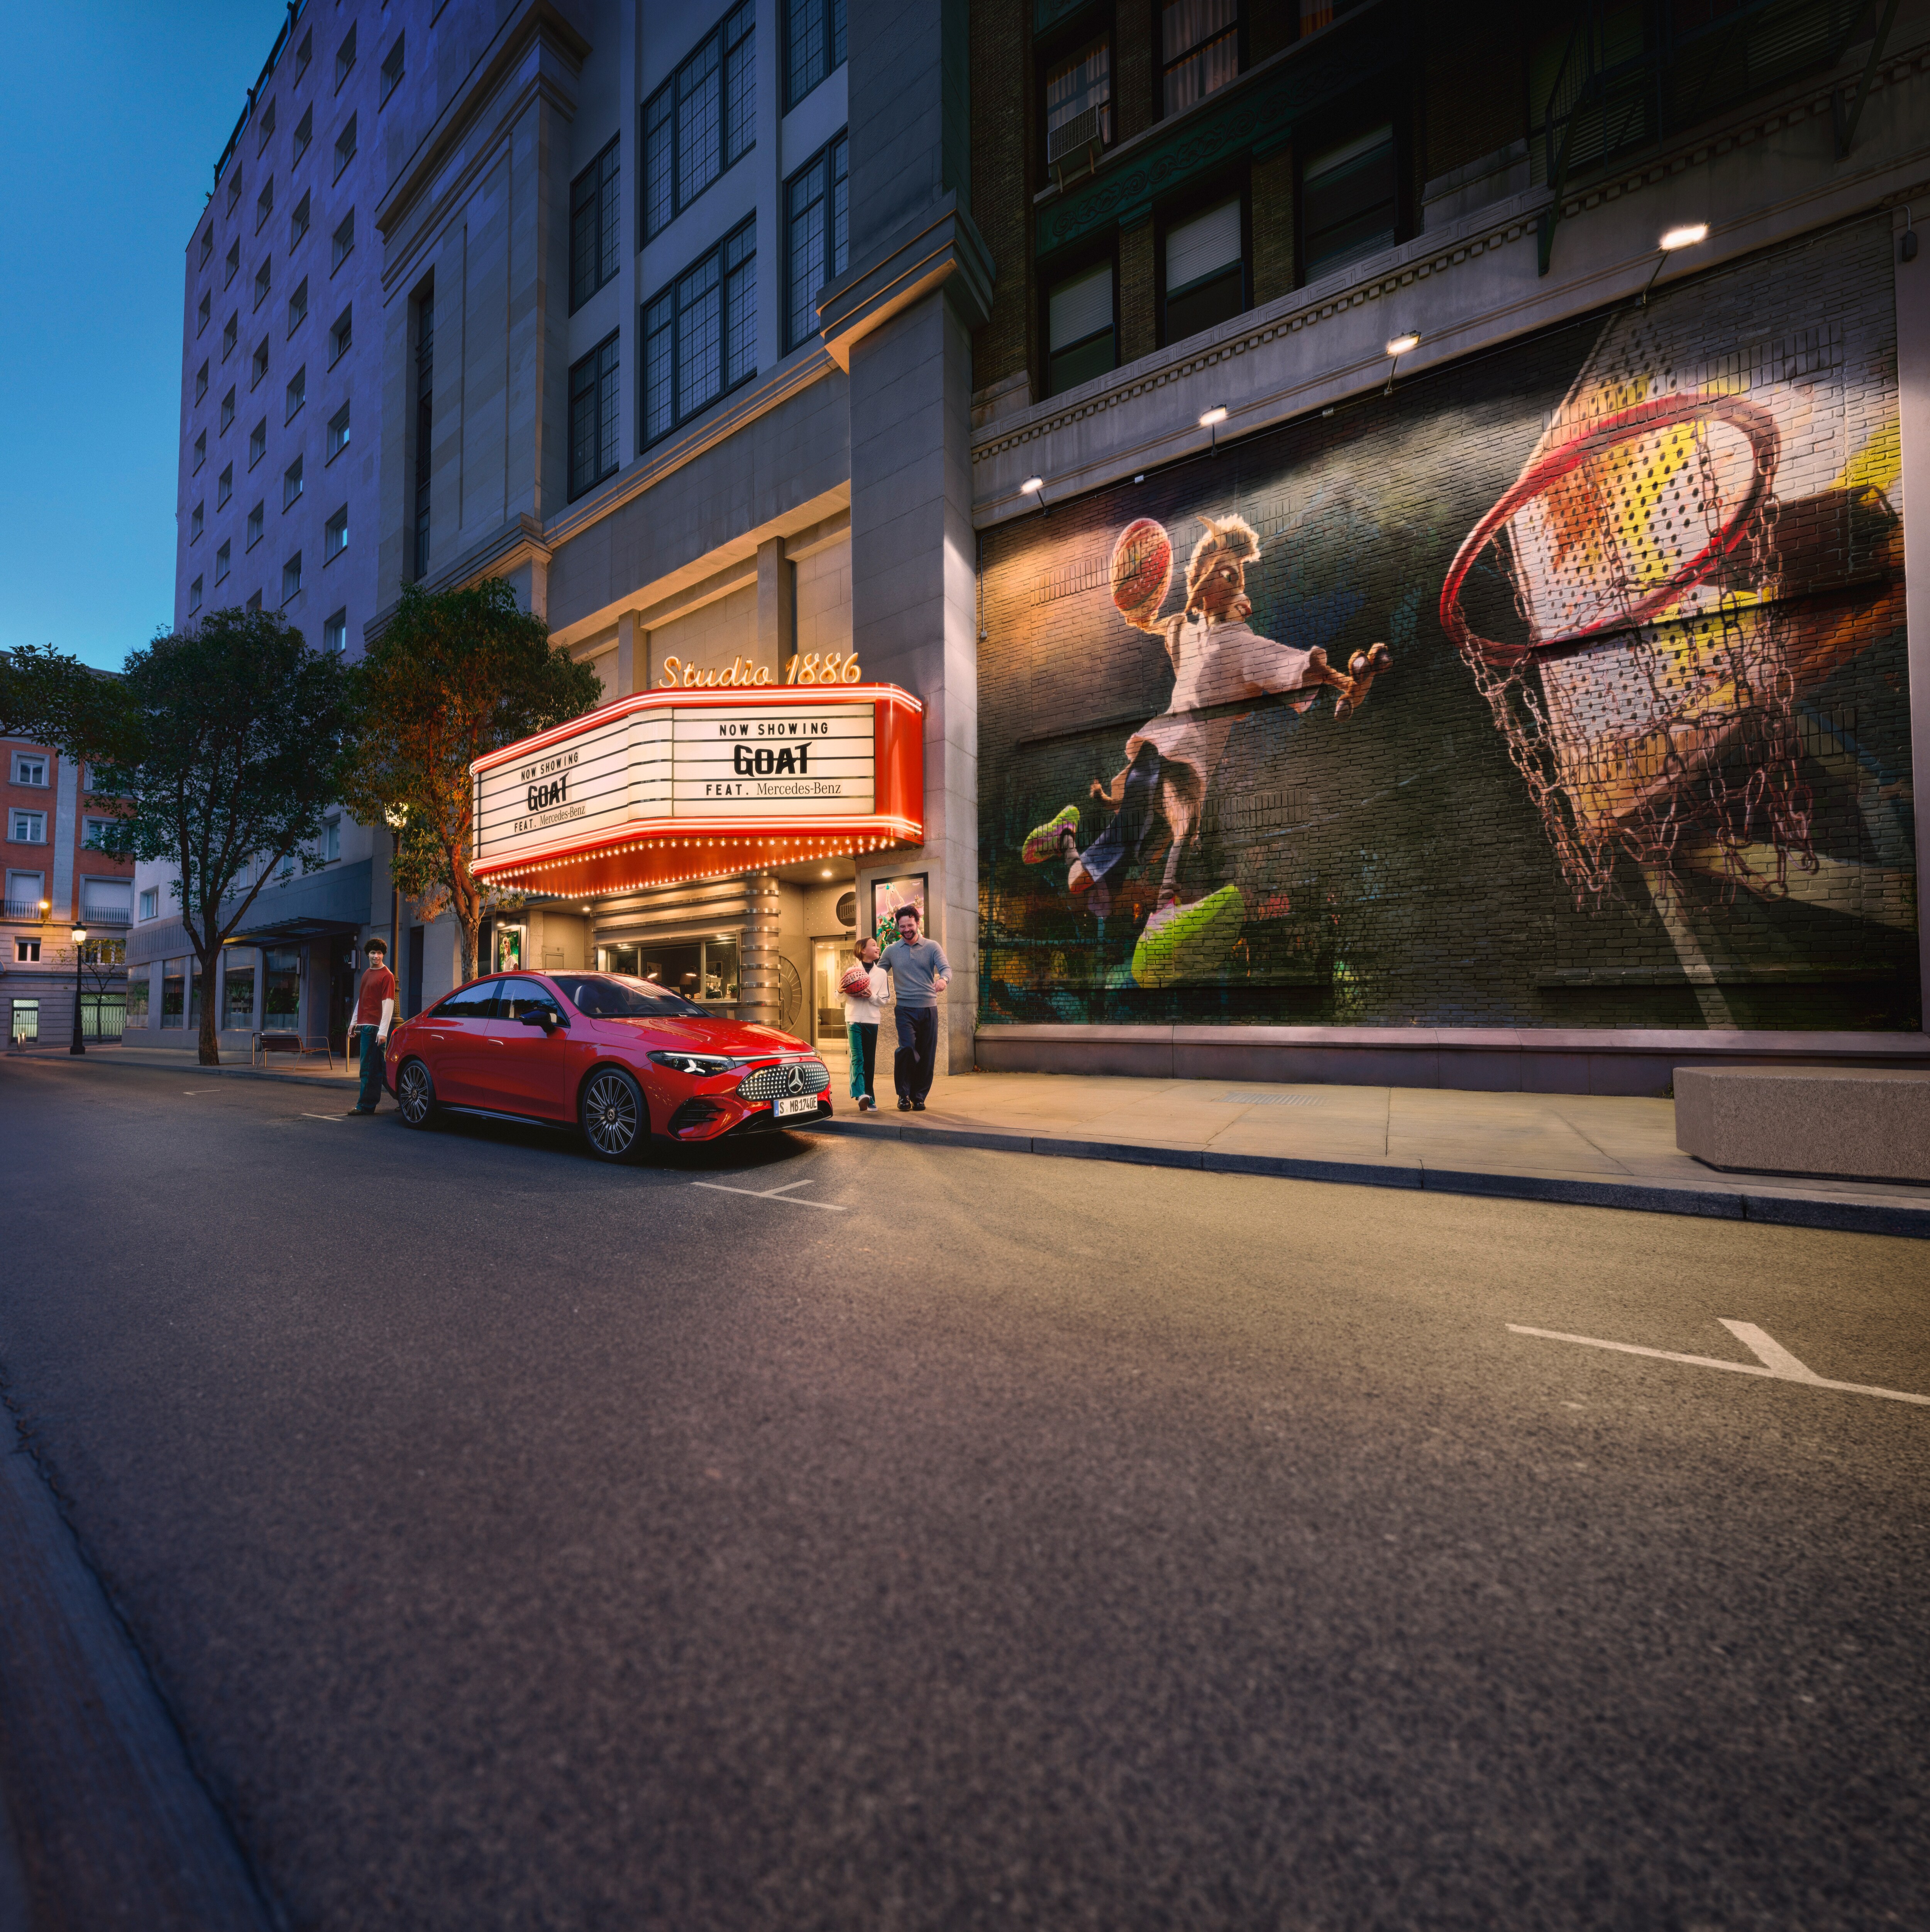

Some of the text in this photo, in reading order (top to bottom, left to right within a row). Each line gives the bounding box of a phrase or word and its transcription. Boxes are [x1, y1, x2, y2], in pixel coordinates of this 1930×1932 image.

[658, 652, 862, 688] Studio 1886
[720, 722, 828, 736] NOW SHOWING
[521, 752, 578, 781] NOW SHOWING
[734, 741, 812, 777] GOAT
[528, 771, 570, 811] GOAT
[706, 782, 841, 796] FEAT. Mercedes-Benz
[515, 806, 585, 832] FEAT. Mercedes-Benz
[780, 1102, 784, 1114] S
